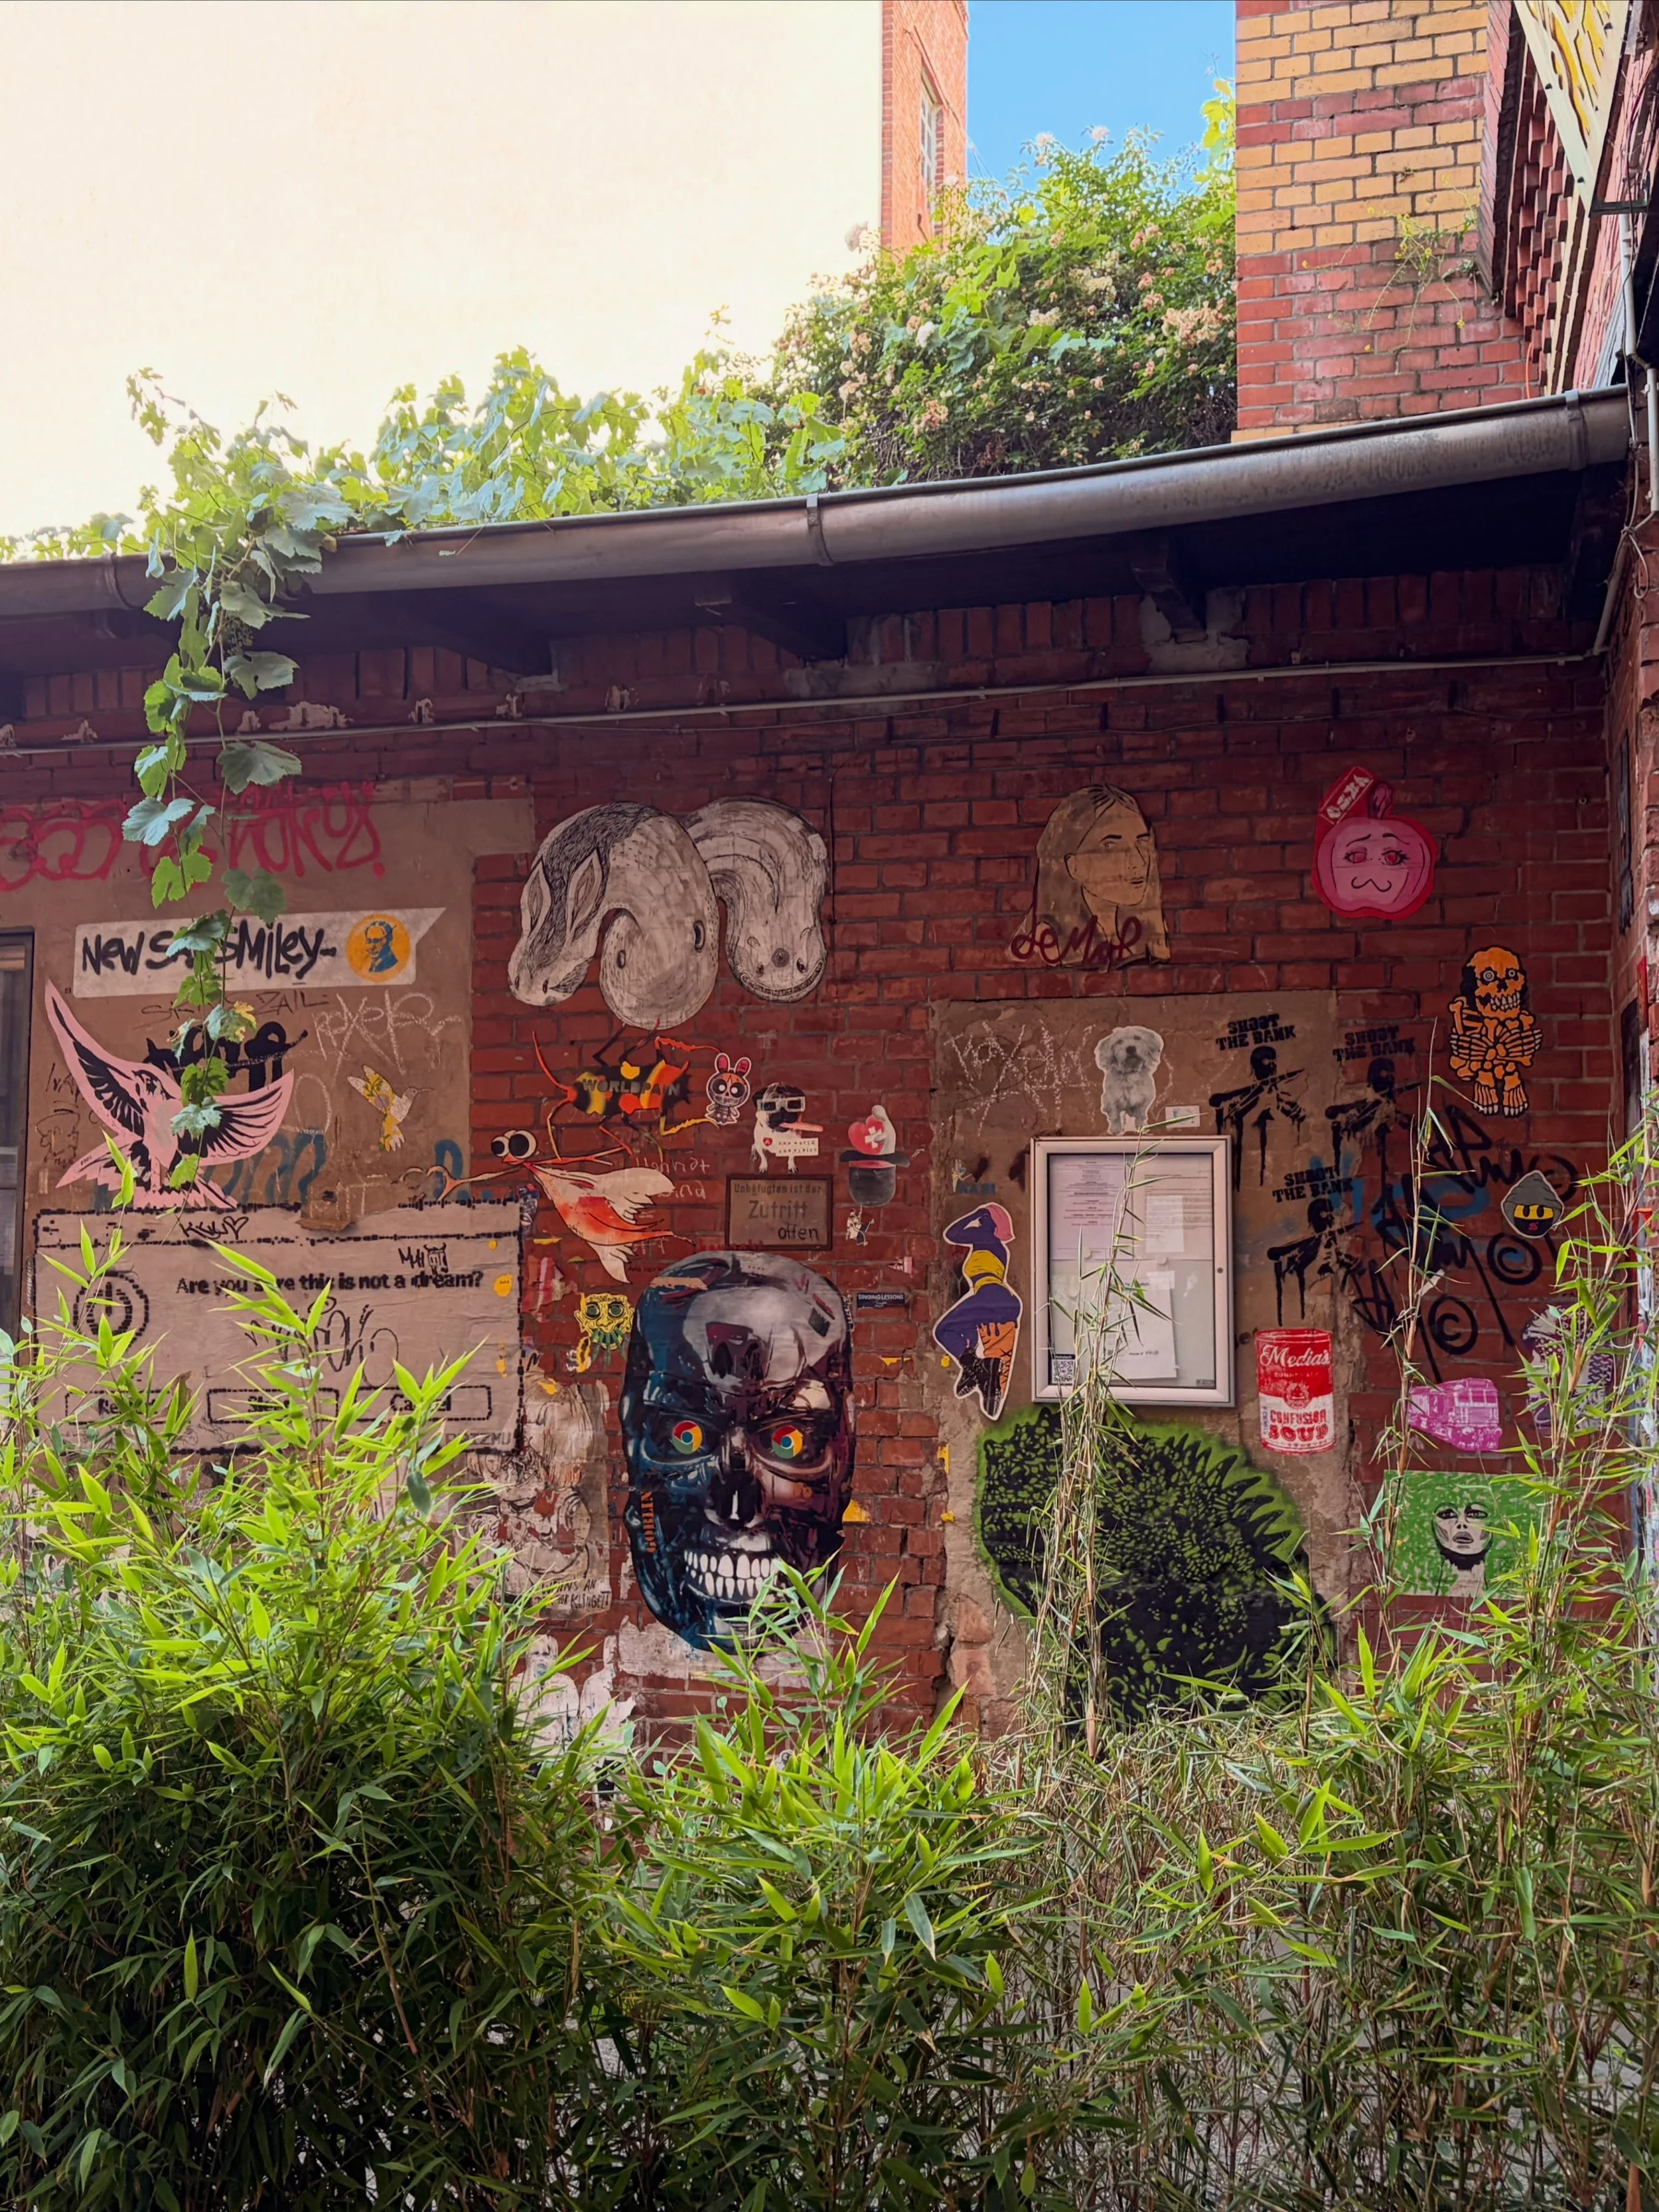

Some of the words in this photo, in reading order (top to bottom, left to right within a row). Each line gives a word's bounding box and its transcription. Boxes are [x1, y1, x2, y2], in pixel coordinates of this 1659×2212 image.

[1228, 1013, 1279, 1035] SHOOT
[1215, 1033, 1250, 1051] THE
[1253, 1025, 1297, 1045] BANK
[1344, 1025, 1400, 1047] SHOOT
[1332, 1045, 1368, 1063] THE
[1370, 1037, 1416, 1058] BANK
[1283, 1165, 1335, 1187] SHOOT
[734, 1183, 787, 1195] Unbefugten
[790, 1183, 803, 1193] ist
[805, 1183, 822, 1193] der
[1272, 1185, 1306, 1203] THE
[1309, 1177, 1354, 1197] BANK
[748, 1200, 808, 1219] Zutritt
[778, 1223, 820, 1241] offen
[176, 1277, 210, 1294] Are
[254, 1276, 295, 1292] sre
[299, 1270, 334, 1291] this
[337, 1271, 356, 1291] is
[358, 1272, 390, 1290] not
[394, 1276, 406, 1288] a
[410, 1270, 484, 1289] dream?
[1269, 1408, 1327, 1425] CONFUSION
[1268, 1424, 1329, 1441] SOUP
[641, 1491, 656, 1554] GOBLIN
